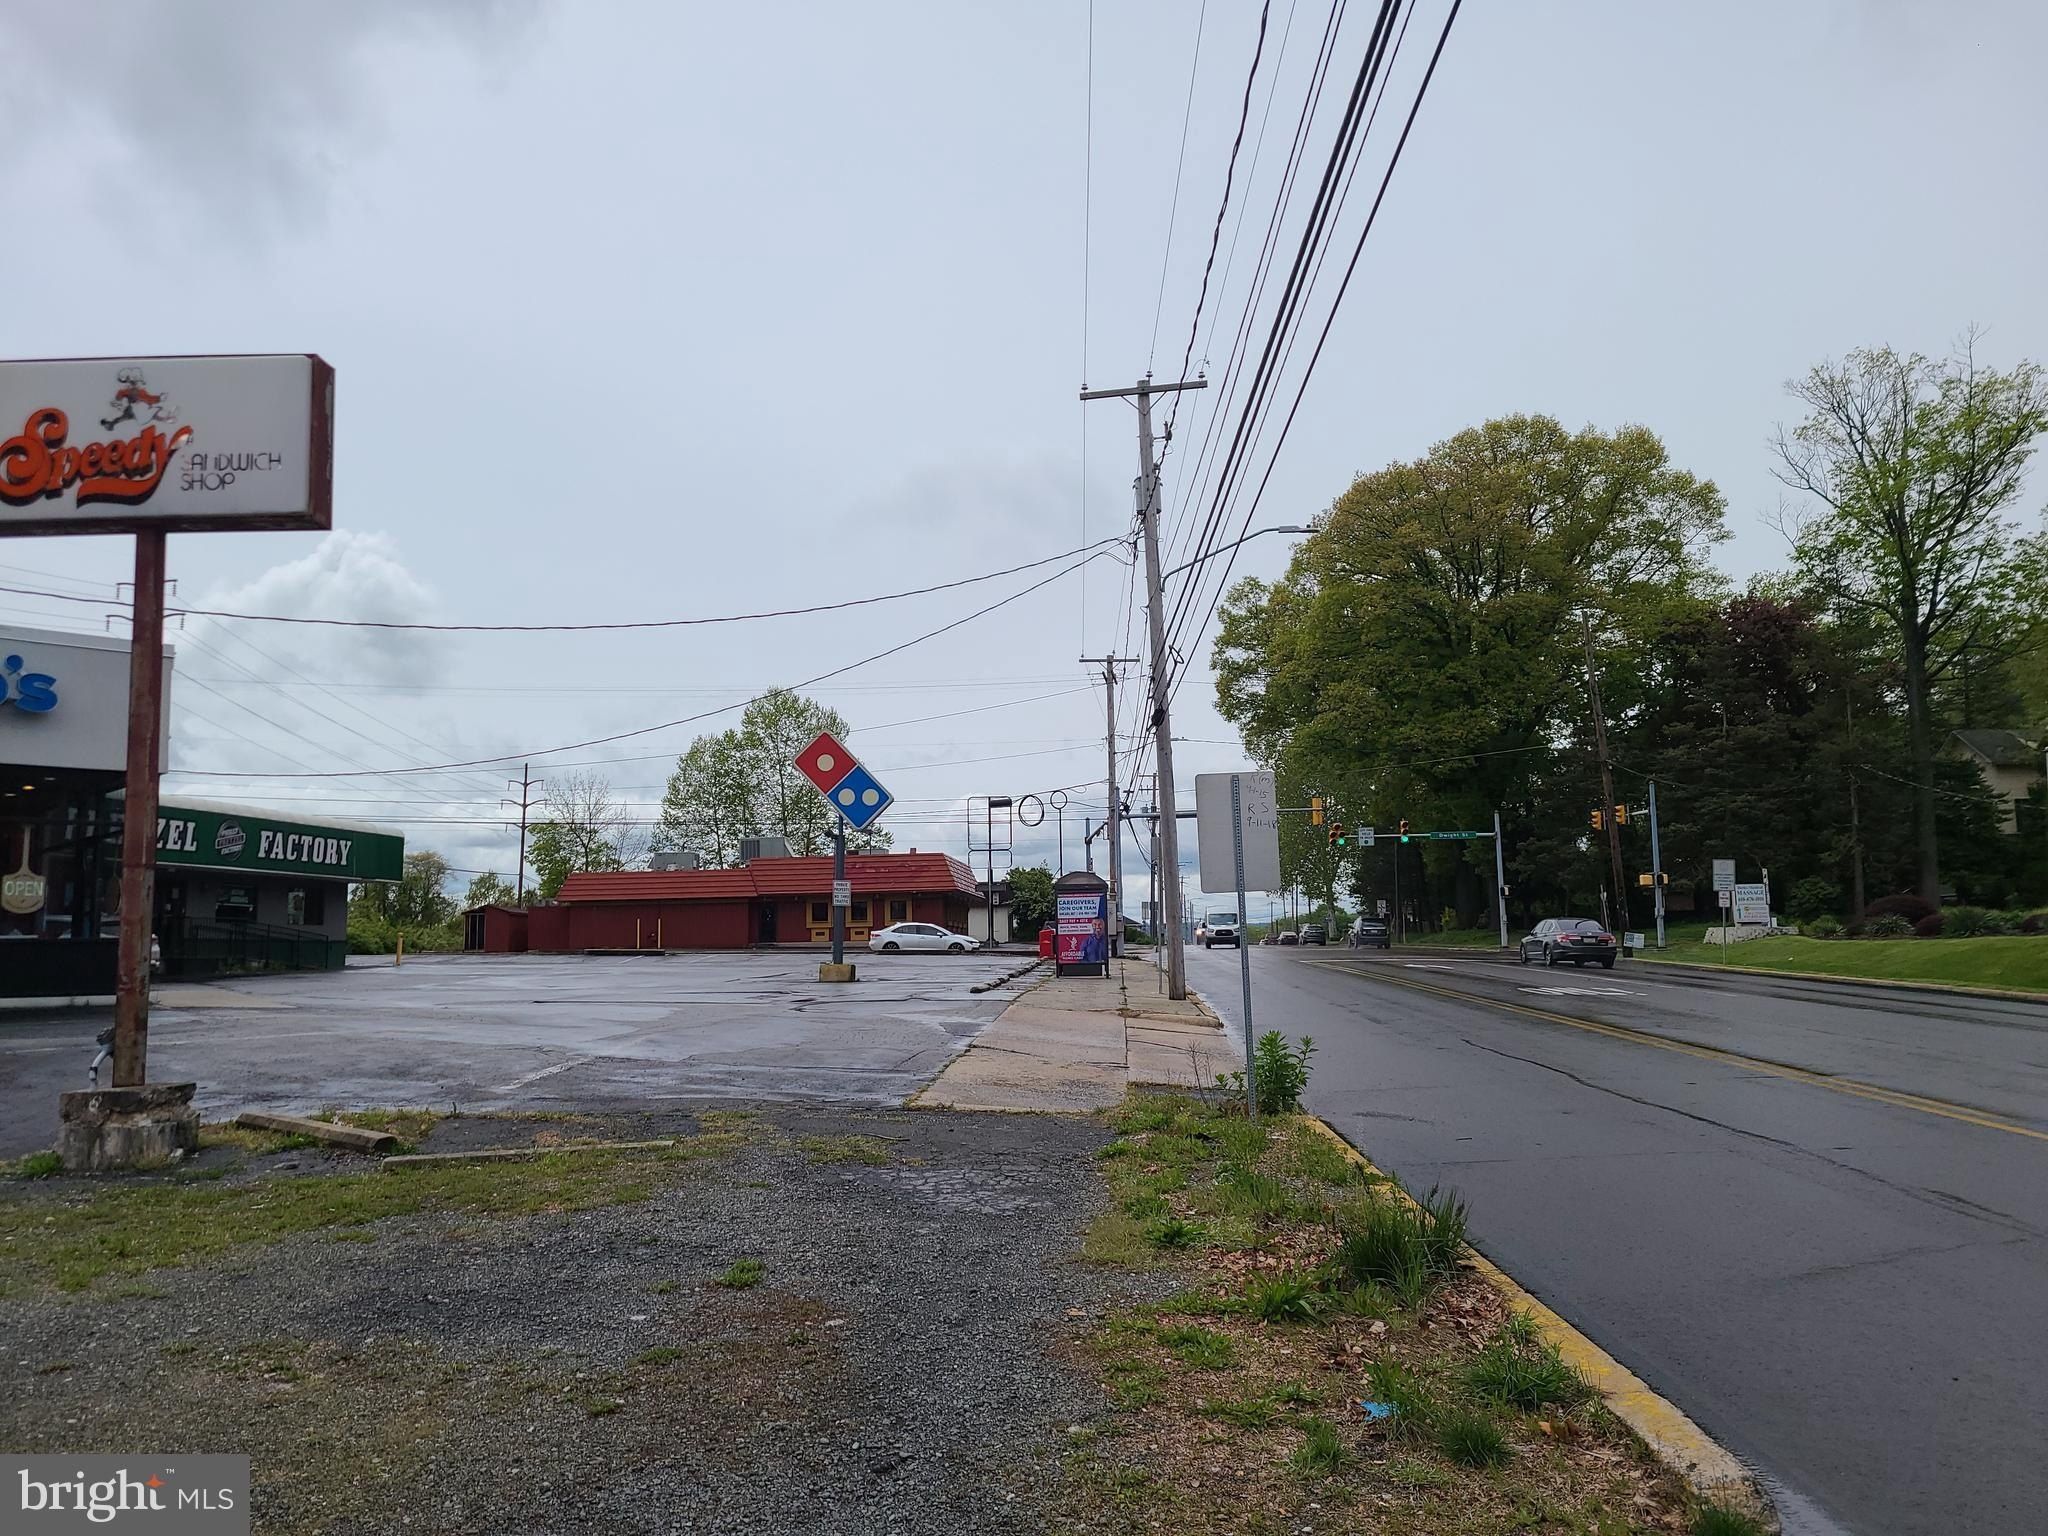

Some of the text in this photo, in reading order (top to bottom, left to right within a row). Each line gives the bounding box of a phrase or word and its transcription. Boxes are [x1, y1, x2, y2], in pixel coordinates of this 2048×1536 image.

[0, 407, 193, 508] Speedy
[180, 472, 235, 492] SHOP
[257, 830, 352, 866] FACTORY
[4, 880, 44, 897] OPEN
